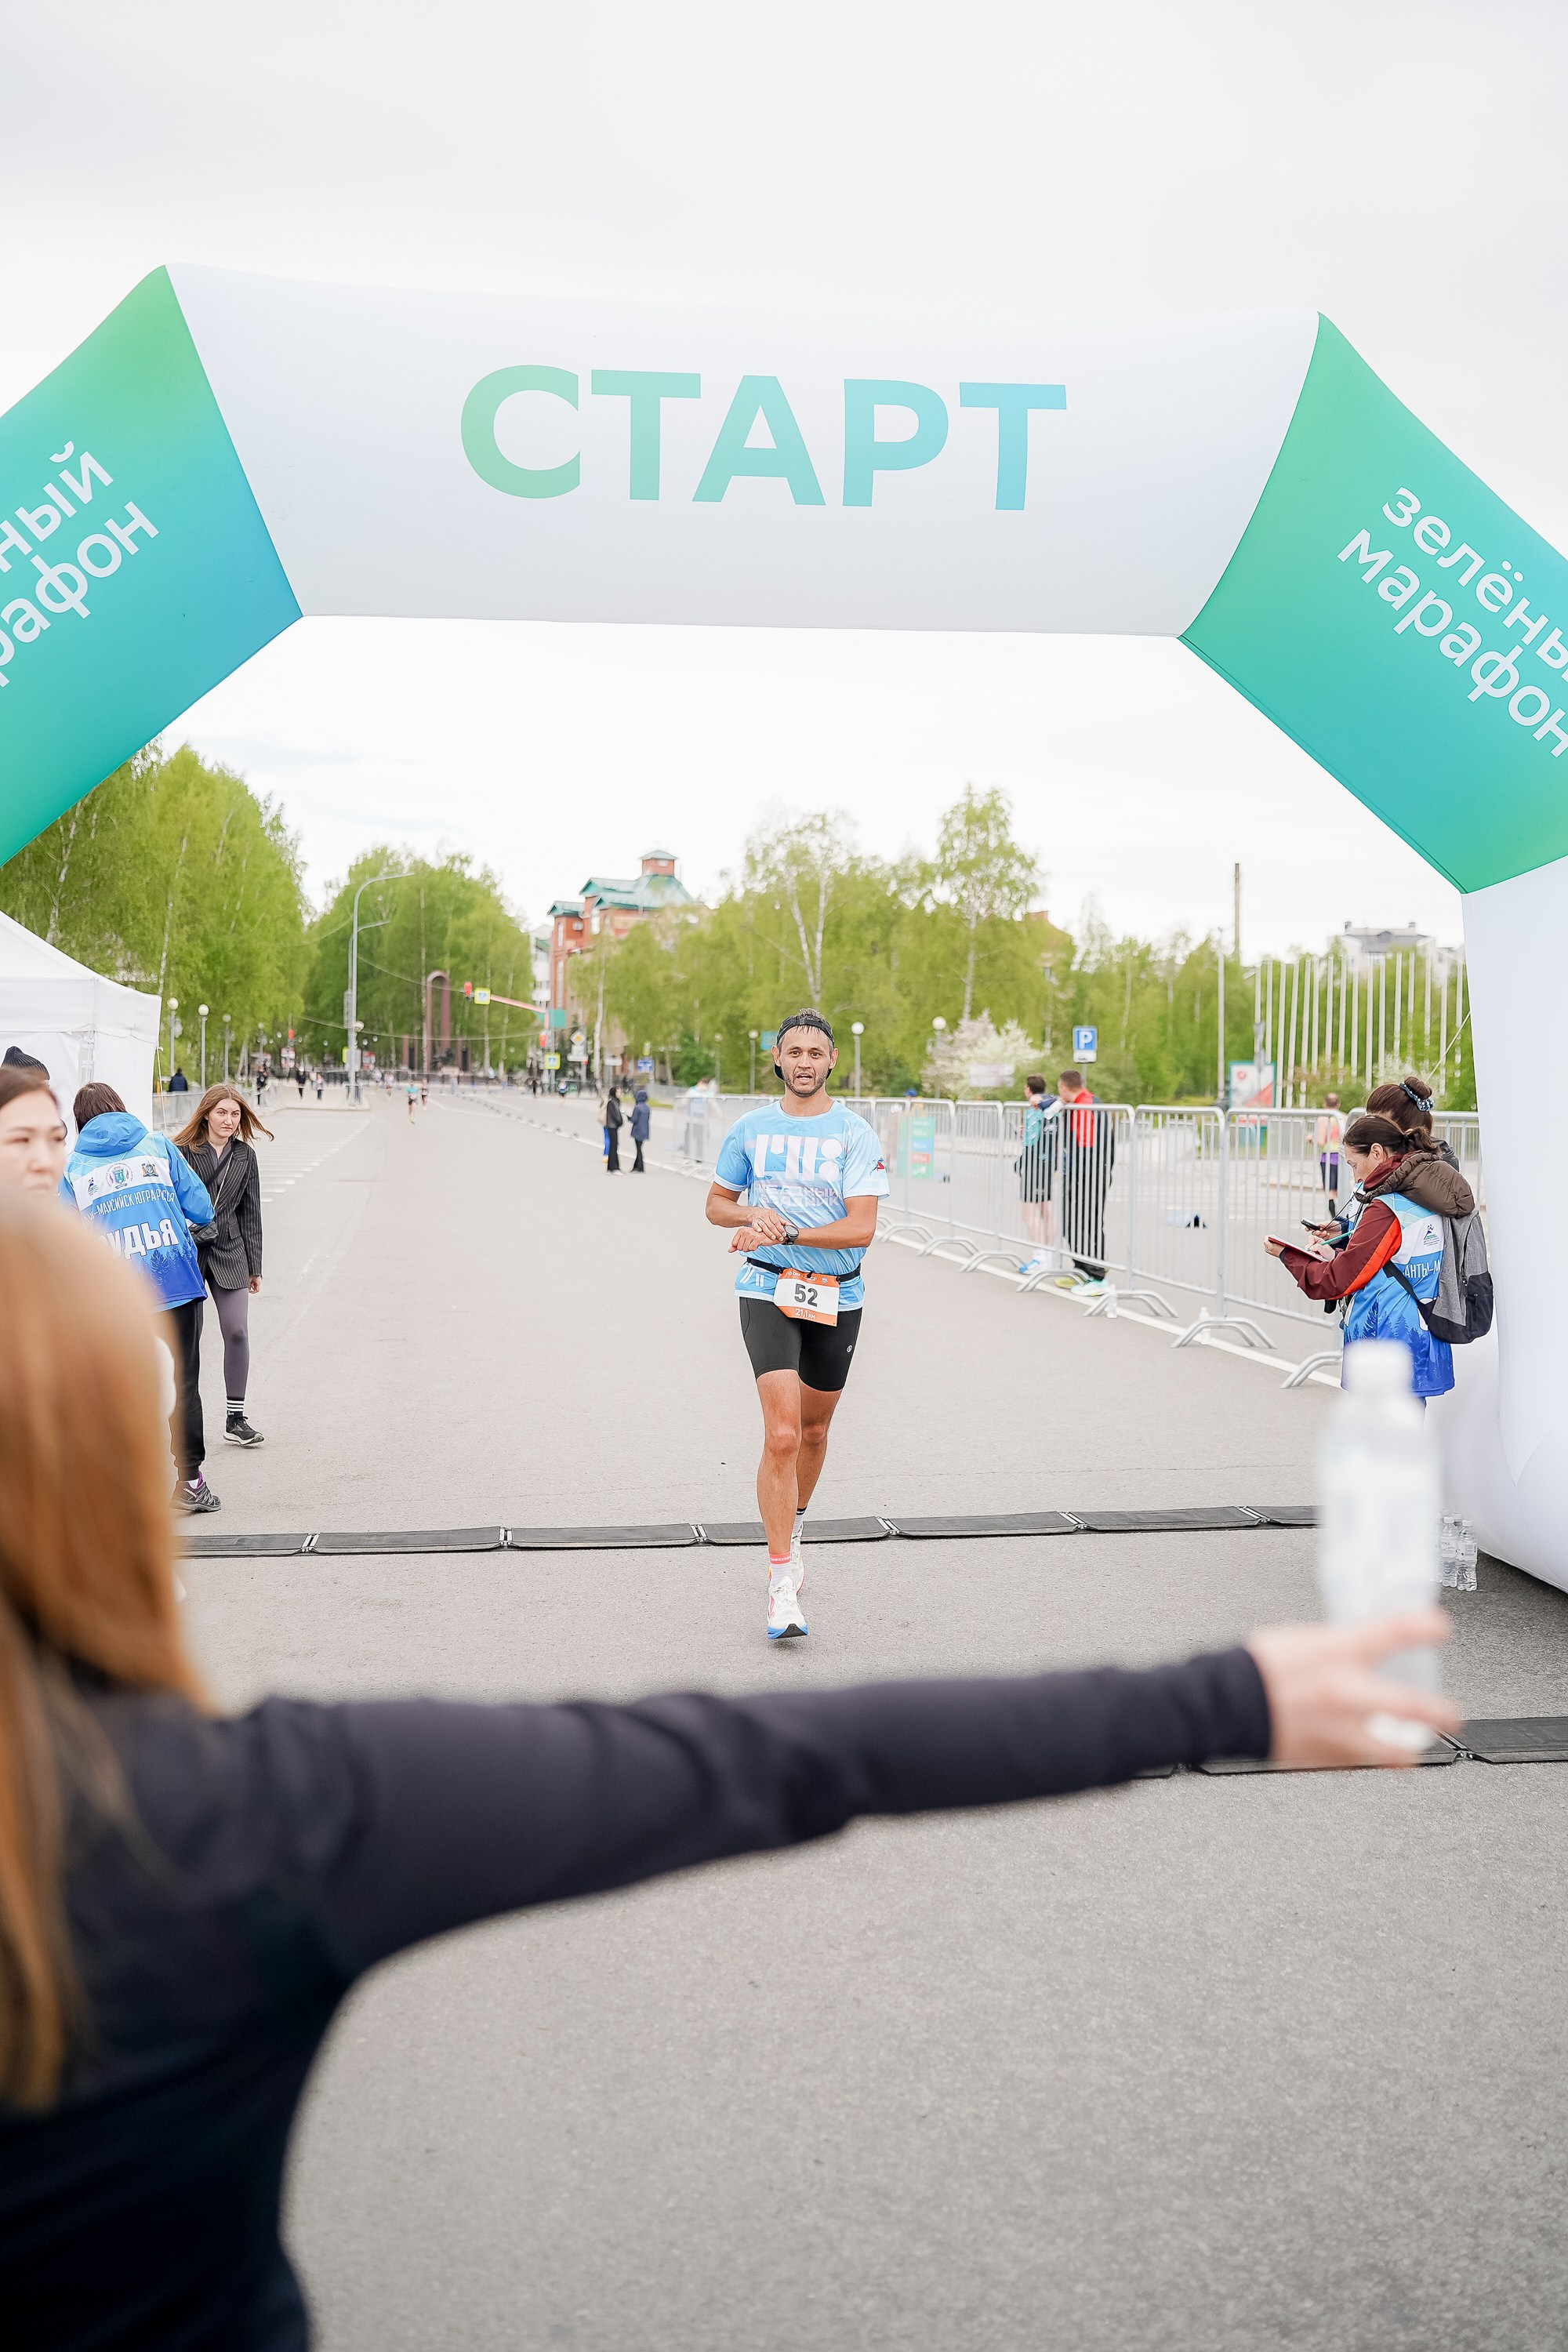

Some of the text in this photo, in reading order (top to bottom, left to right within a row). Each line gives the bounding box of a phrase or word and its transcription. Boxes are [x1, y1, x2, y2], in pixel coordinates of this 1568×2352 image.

[461, 365, 1067, 511] СТАРТ
[1336, 528, 1568, 759] марафон
[1079, 1031, 1094, 1050] P
[134, 1189, 156, 1205] ЮГРА
[794, 1283, 818, 1307] 52
